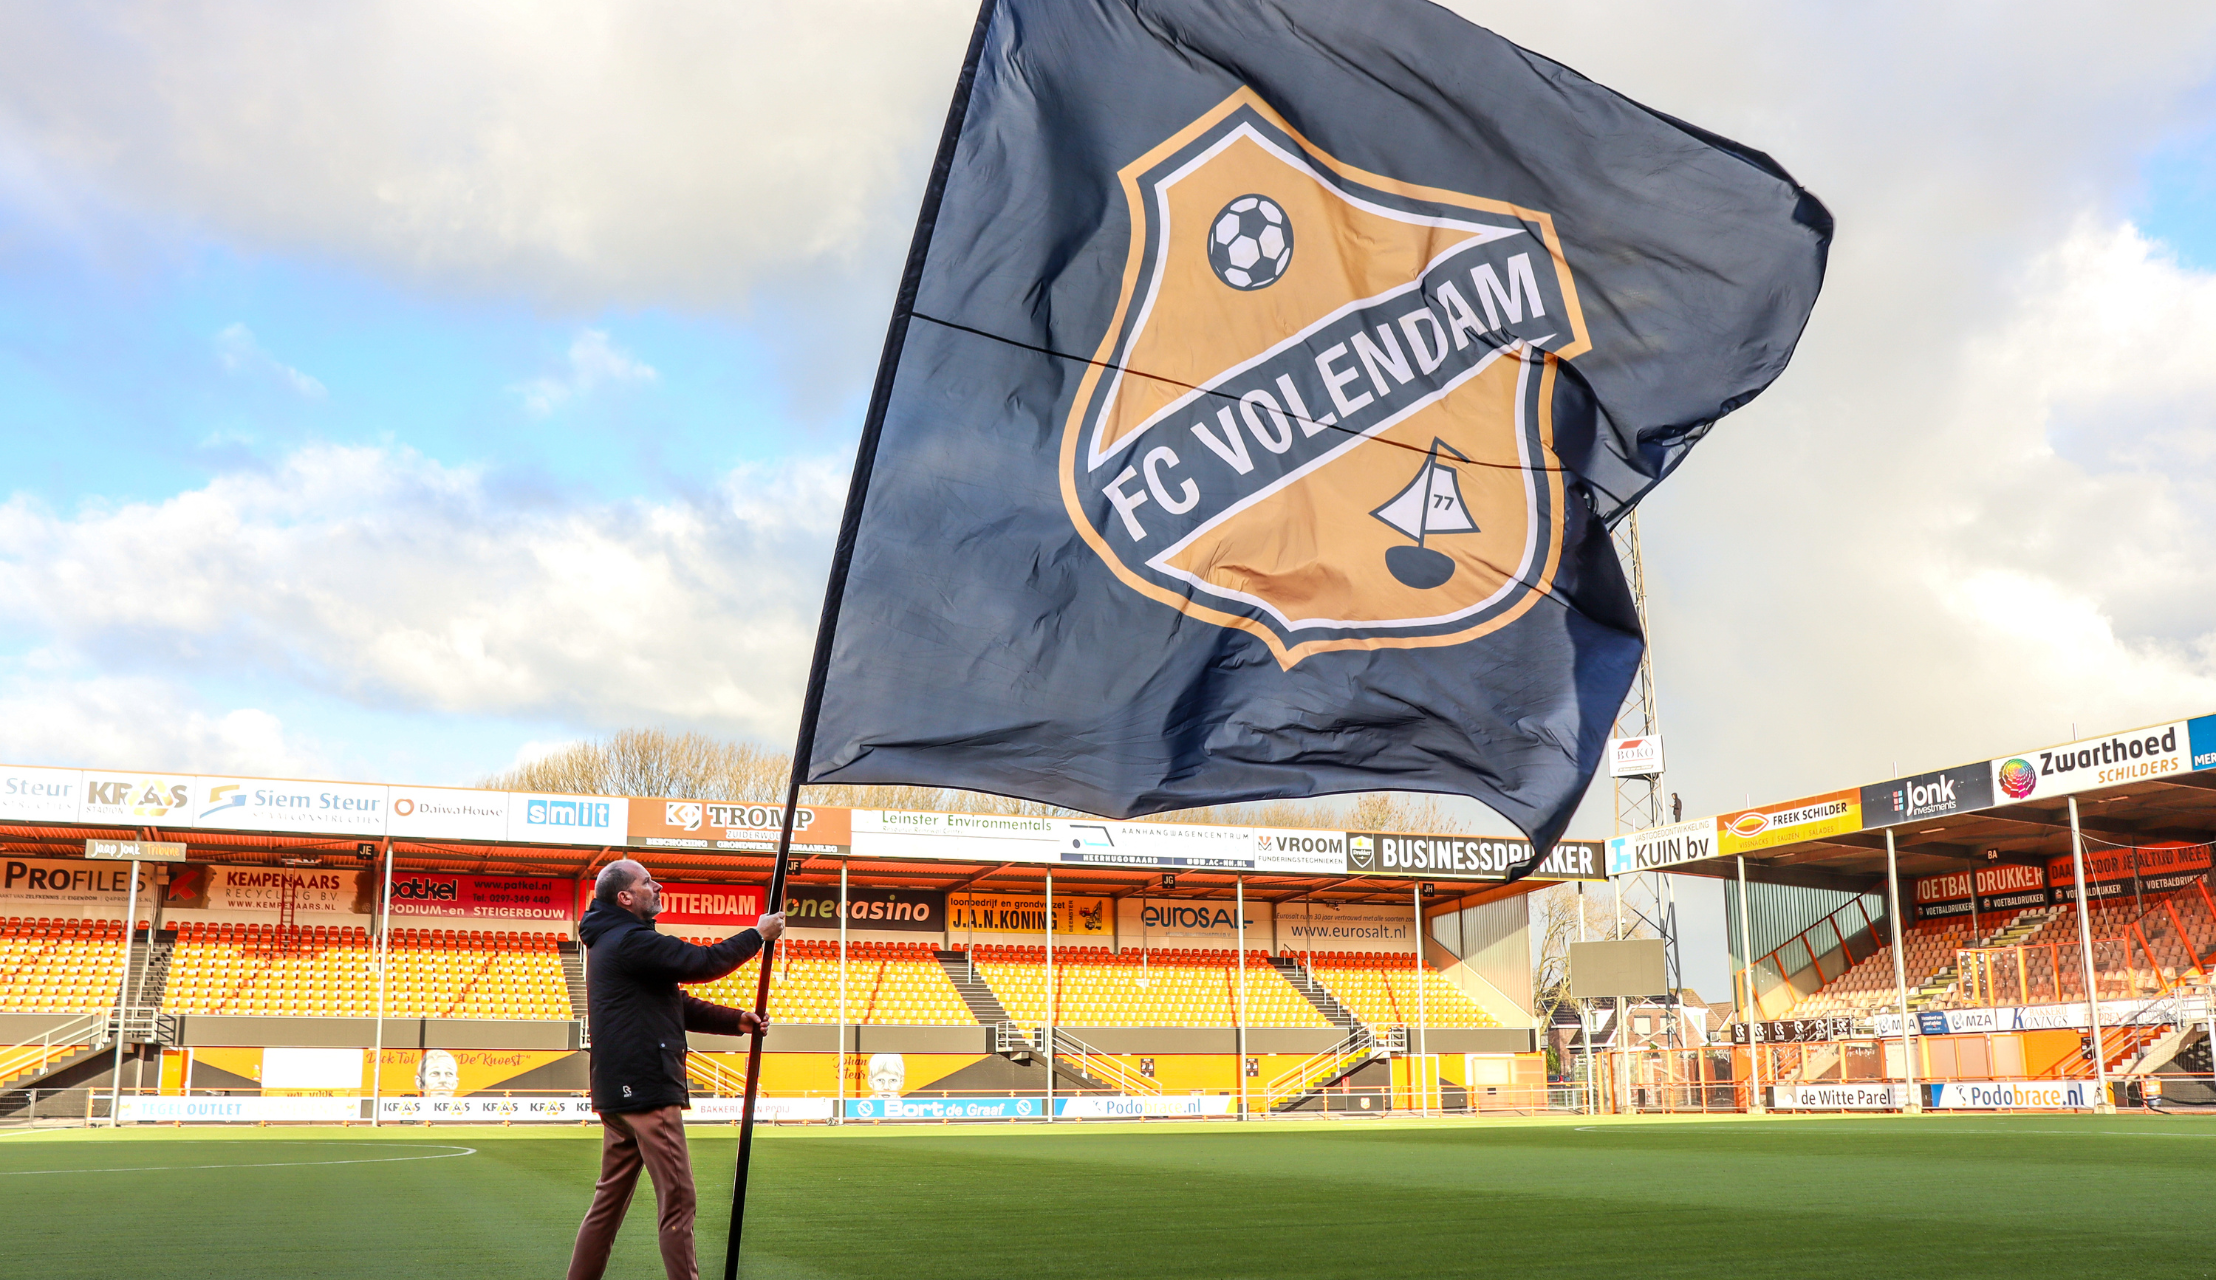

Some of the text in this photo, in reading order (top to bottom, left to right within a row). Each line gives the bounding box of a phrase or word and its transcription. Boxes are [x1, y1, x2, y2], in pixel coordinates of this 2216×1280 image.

[1102, 252, 1545, 542] FC VOLENDAM
[1433, 494, 1454, 510] 77
[1618, 748, 1654, 760] BOKO
[2040, 726, 2176, 776] Zwarthoed
[2098, 757, 2179, 783] SCHILDERS
[5, 777, 73, 797] Steur
[254, 789, 381, 811] Siem Steur
[1906, 774, 1956, 816] jonk
[86, 806, 124, 814] STADION
[528, 802, 608, 826] smit
[1773, 802, 1847, 826] FREEK SCHILDER
[1913, 800, 1956, 815] investments
[882, 811, 1051, 831] Leinster Environmentals
[726, 830, 794, 840] ZUIDERWOU
[1122, 828, 1249, 840] AANHANGWAGENCENTRUM
[1635, 820, 1710, 842] VASTGOEDONTWIKKELING
[1739, 826, 1834, 848] VISSNACKS SAUZEN SALADES
[91, 841, 180, 858] Jaap Jonk Tribune
[360, 845, 372, 856] JE
[717, 841, 774, 850] GRONDWERK
[1276, 837, 1343, 853] VROOM
[1636, 836, 1709, 868] KUIN bv
[1083, 854, 1158, 864] HEERHUGOWAARD
[1258, 855, 1343, 864] FUNDERINGSTECHNIEKEN
[1987, 850, 1998, 859] BA
[788, 862, 799, 871] JF
[2051, 864, 2074, 880] DAA
[2083, 858, 2119, 876] SCOOR
[2138, 850, 2174, 868] ALTIJD
[227, 871, 340, 890] KEMPENAARS
[474, 880, 552, 891] www.patkel.nl
[1163, 875, 1174, 884] JG
[226, 888, 340, 901] RECYCLING B.V.
[473, 893, 550, 904] Tel. 0297-349 440
[1993, 894, 2044, 908] VOETBALDRUKKER
[228, 900, 336, 911] WWW.KEMPENAARS.NL
[660, 892, 756, 916] OTTERDAM
[1001, 900, 1011, 908] en
[1014, 900, 1065, 909] grondvzet
[474, 906, 565, 919] STEIGERBOUW
[1276, 912, 1299, 920] Eurosalt
[1334, 914, 1362, 922] vertrouwd
[1291, 924, 1406, 939] www.eurosalt.nl
[2011, 1007, 2069, 1030] KONINGS
[2029, 1006, 2067, 1016] BAKKERIJ
[1892, 1019, 1916, 1030] MA
[1966, 1014, 1992, 1027] MZA
[366, 1051, 395, 1064] Dck
[396, 1051, 417, 1064] Tol
[1801, 1090, 1816, 1105] de
[1819, 1090, 1854, 1105] Witte
[1858, 1088, 1891, 1105] Parel
[1971, 1083, 2084, 1106] Podobrace.nl
[142, 1103, 182, 1115] TEGEL
[187, 1103, 242, 1115] OUTLET
[884, 1100, 1005, 1117] Bort de Graaf
[1106, 1098, 1201, 1114] Podobrace.nl
